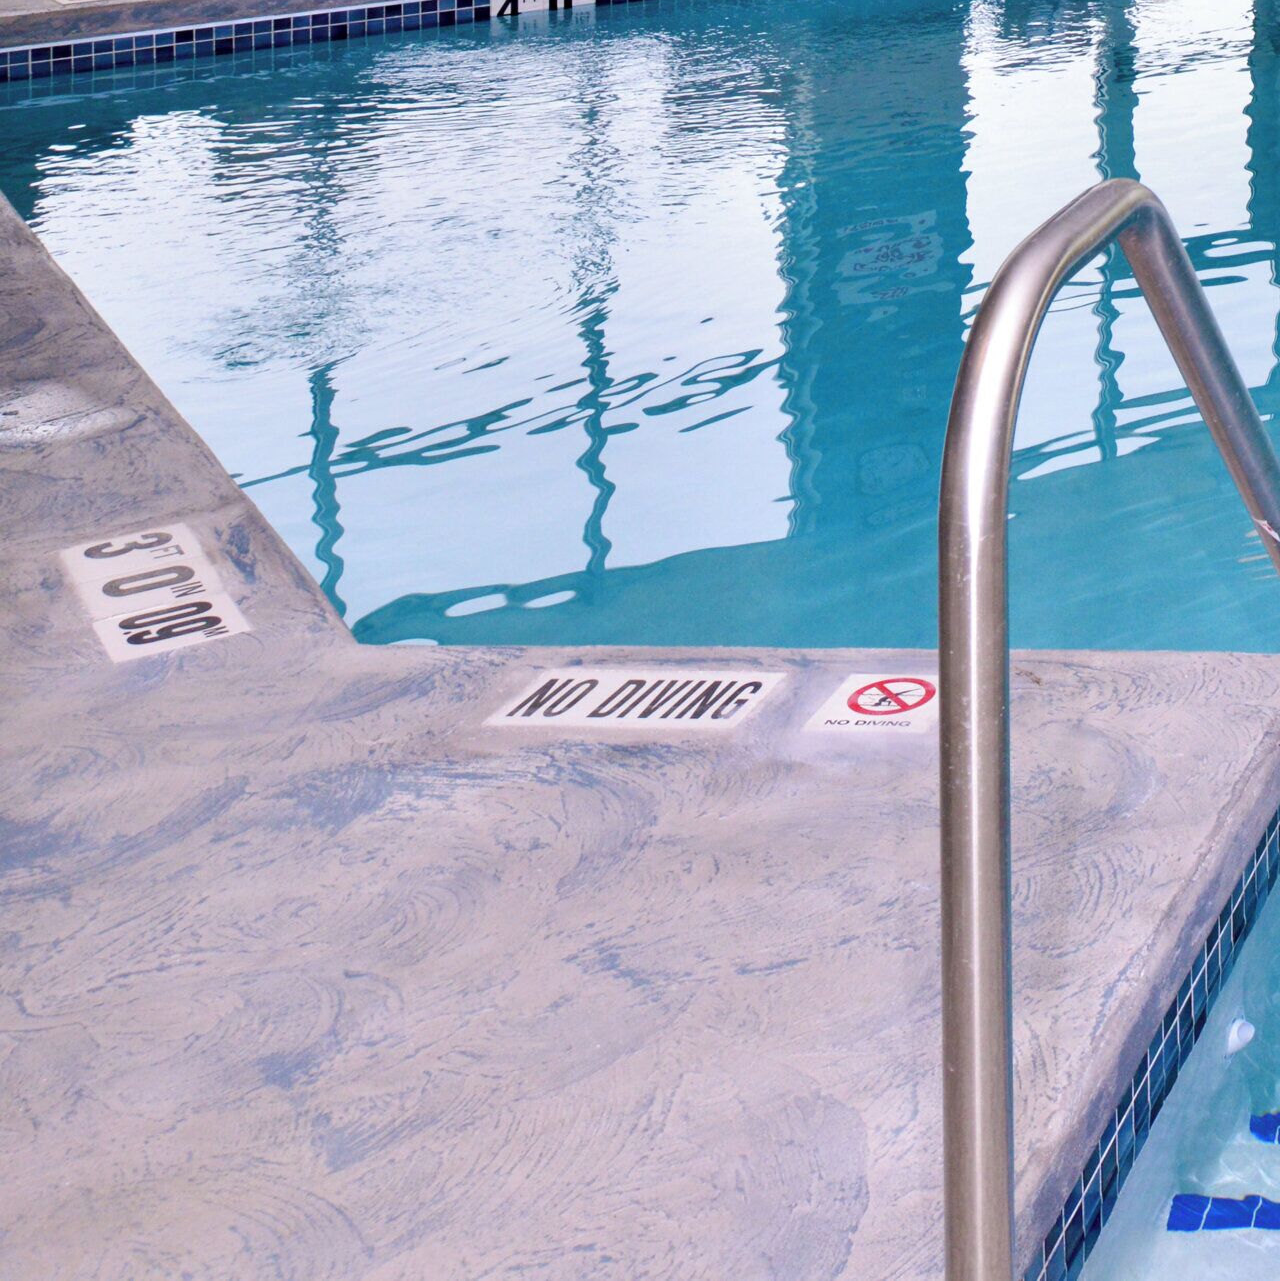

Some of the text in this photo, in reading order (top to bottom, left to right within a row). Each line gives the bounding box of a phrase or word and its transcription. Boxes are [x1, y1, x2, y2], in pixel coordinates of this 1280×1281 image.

[505, 679, 763, 719] NO DIVING
[855, 719, 912, 727] DIVING
